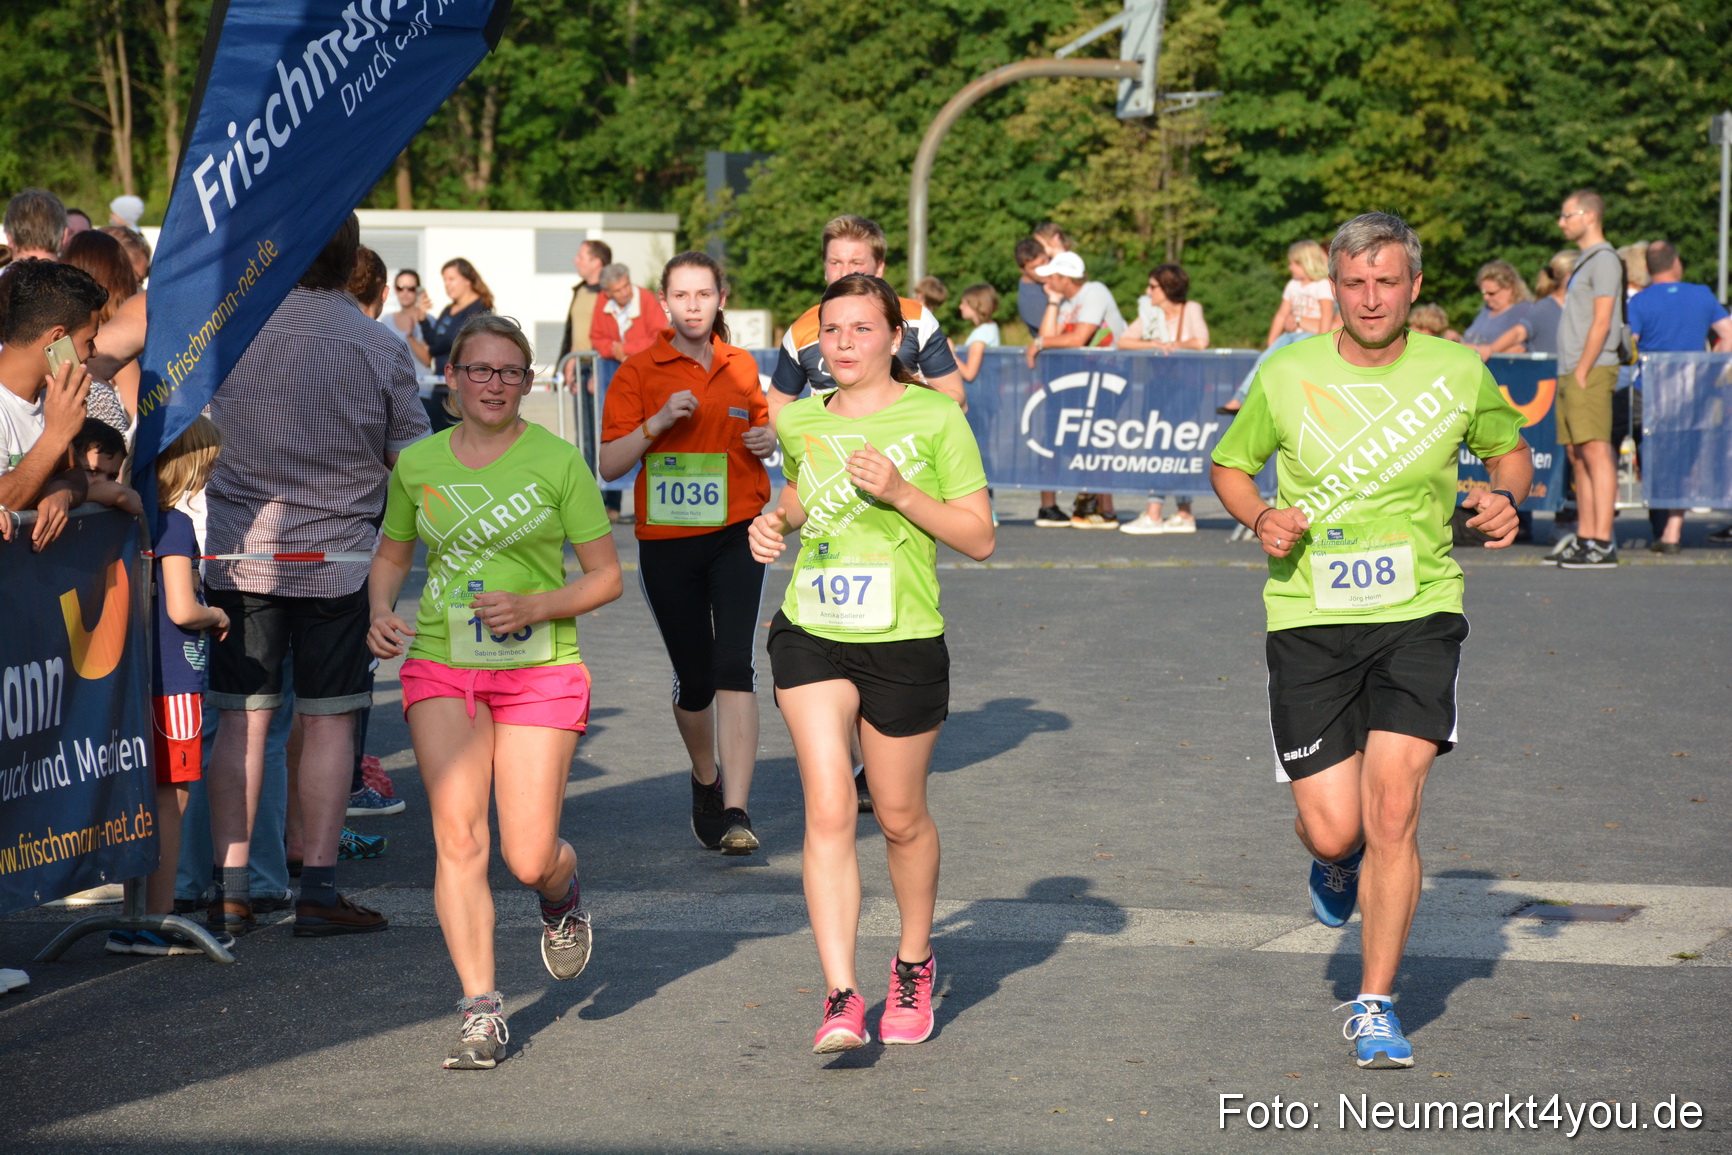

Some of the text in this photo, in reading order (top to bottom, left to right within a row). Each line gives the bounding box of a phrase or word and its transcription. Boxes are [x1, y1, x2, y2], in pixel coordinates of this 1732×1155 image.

[340, 39, 397, 118] Druck
[192, 0, 408, 234] Frischman
[137, 239, 279, 425] ww.frischmann-net.de
[1054, 408, 1219, 451] Fischer
[1294, 375, 1455, 525] BURKHARDT
[1069, 453, 1203, 474] AUTOMOBILE
[1320, 401, 1468, 525] RGIE- UND GEBÄUDETECHNIK
[656, 481, 719, 506] 1036
[838, 512, 855, 529] UND
[481, 506, 553, 562] GEBÄUDETECHNIK
[811, 574, 873, 606] 197
[1329, 556, 1396, 588] 208
[0, 656, 64, 741] ann
[31, 740, 71, 793] und
[73, 729, 147, 782] Medien
[1283, 738, 1323, 762] saller
